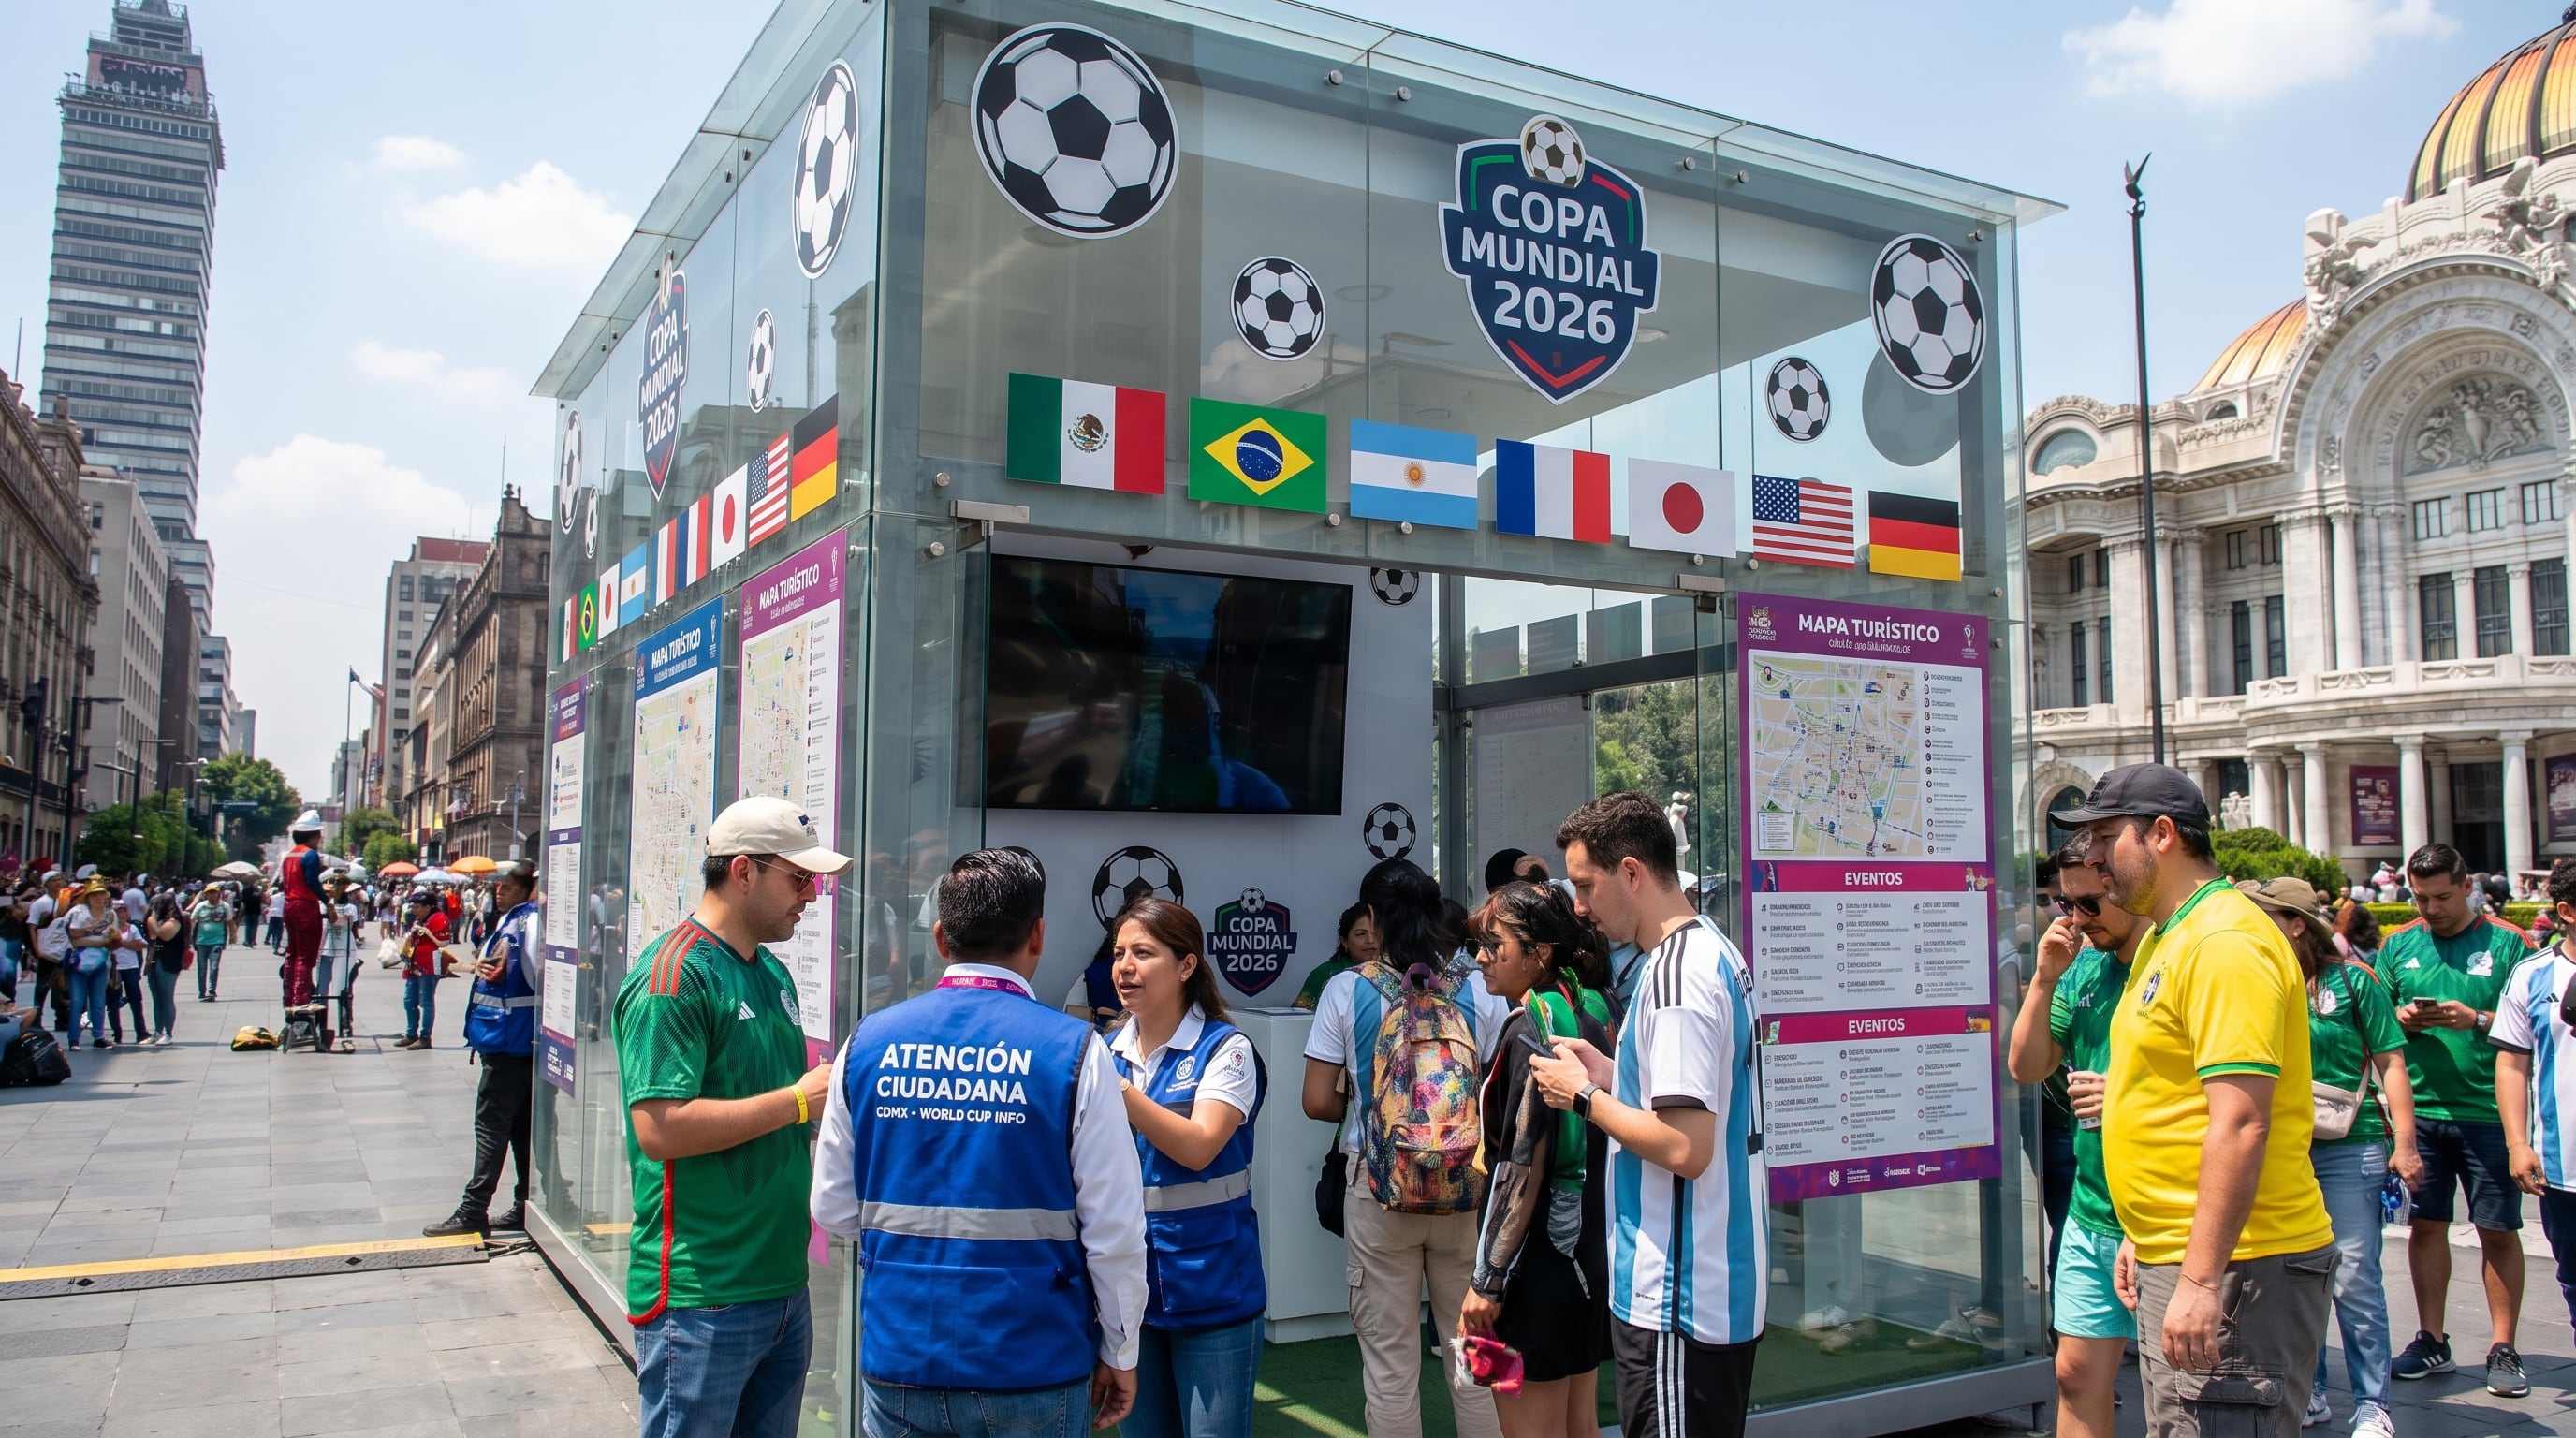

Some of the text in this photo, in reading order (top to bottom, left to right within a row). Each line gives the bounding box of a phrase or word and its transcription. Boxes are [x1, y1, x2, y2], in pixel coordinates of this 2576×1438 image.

[1491, 184, 1615, 248] COPA
[1461, 227, 1644, 297] MUNDIAL
[1494, 281, 1616, 344] 2026
[649, 309, 678, 368] COPA
[640, 345, 684, 412] MUNDIAL
[645, 391, 676, 453] 2026
[780, 563, 820, 600] TURÍSTICO
[1798, 613, 1850, 636] MAPA
[1852, 616, 1939, 643] TURÍSTICO
[1845, 872, 1903, 886] EVENTOS
[1229, 917, 1278, 932] COPA
[1212, 935, 1293, 950] MUNDIAL
[1226, 954, 1278, 972] 2026
[1848, 1018, 1906, 1034] EVENTOS
[878, 1041, 1032, 1076] ATENCIÓN
[876, 1076, 1028, 1105] CIUDADANA
[876, 1106, 909, 1119] CDMX
[919, 1108, 964, 1122] WORLD
[967, 1109, 992, 1123] CUP
[995, 1111, 1026, 1124] INFO
